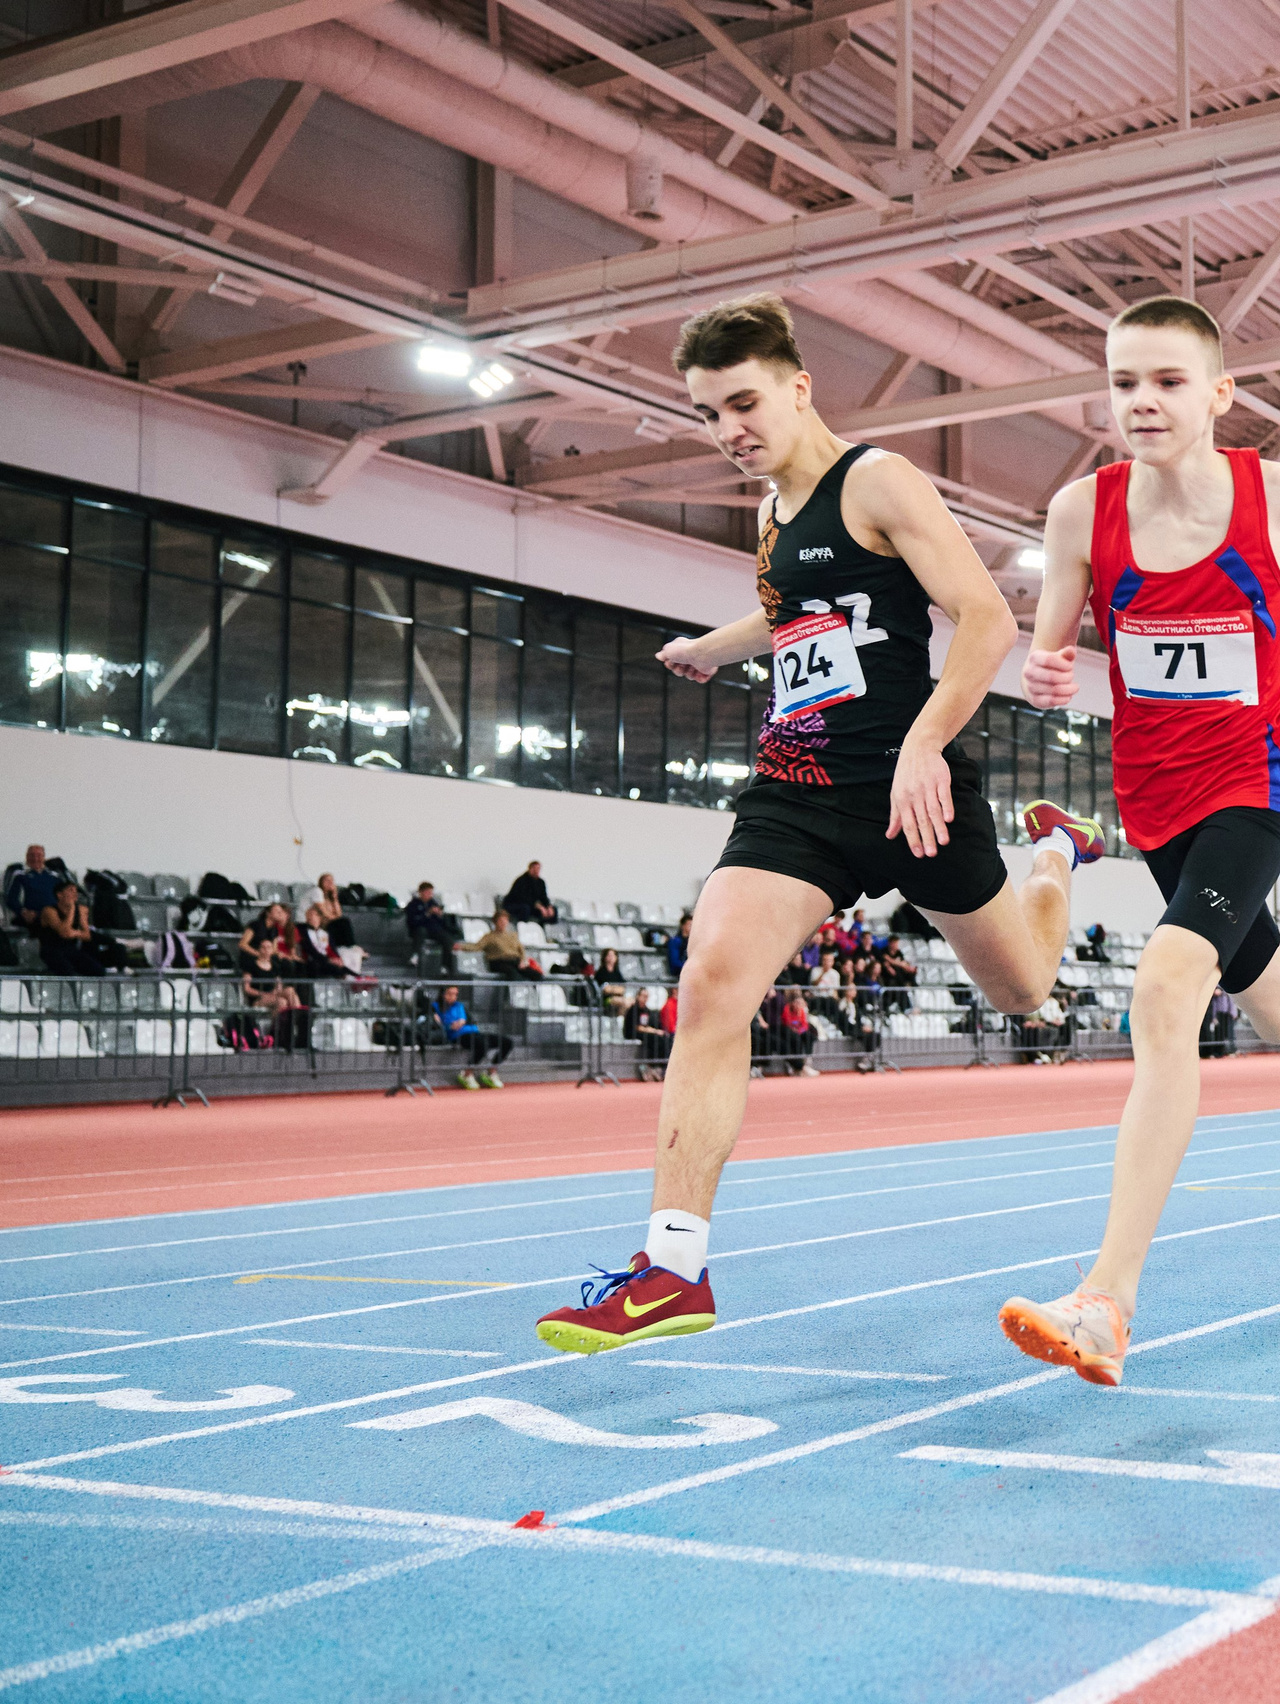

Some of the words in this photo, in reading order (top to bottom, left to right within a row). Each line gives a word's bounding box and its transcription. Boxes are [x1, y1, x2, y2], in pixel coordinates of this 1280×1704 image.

[1191, 616, 1240, 624] соревнования
[1194, 623, 1248, 633] Отечества»
[778, 641, 834, 693] 124
[1154, 642, 1207, 679] 71
[346, 1396, 780, 1449] 2
